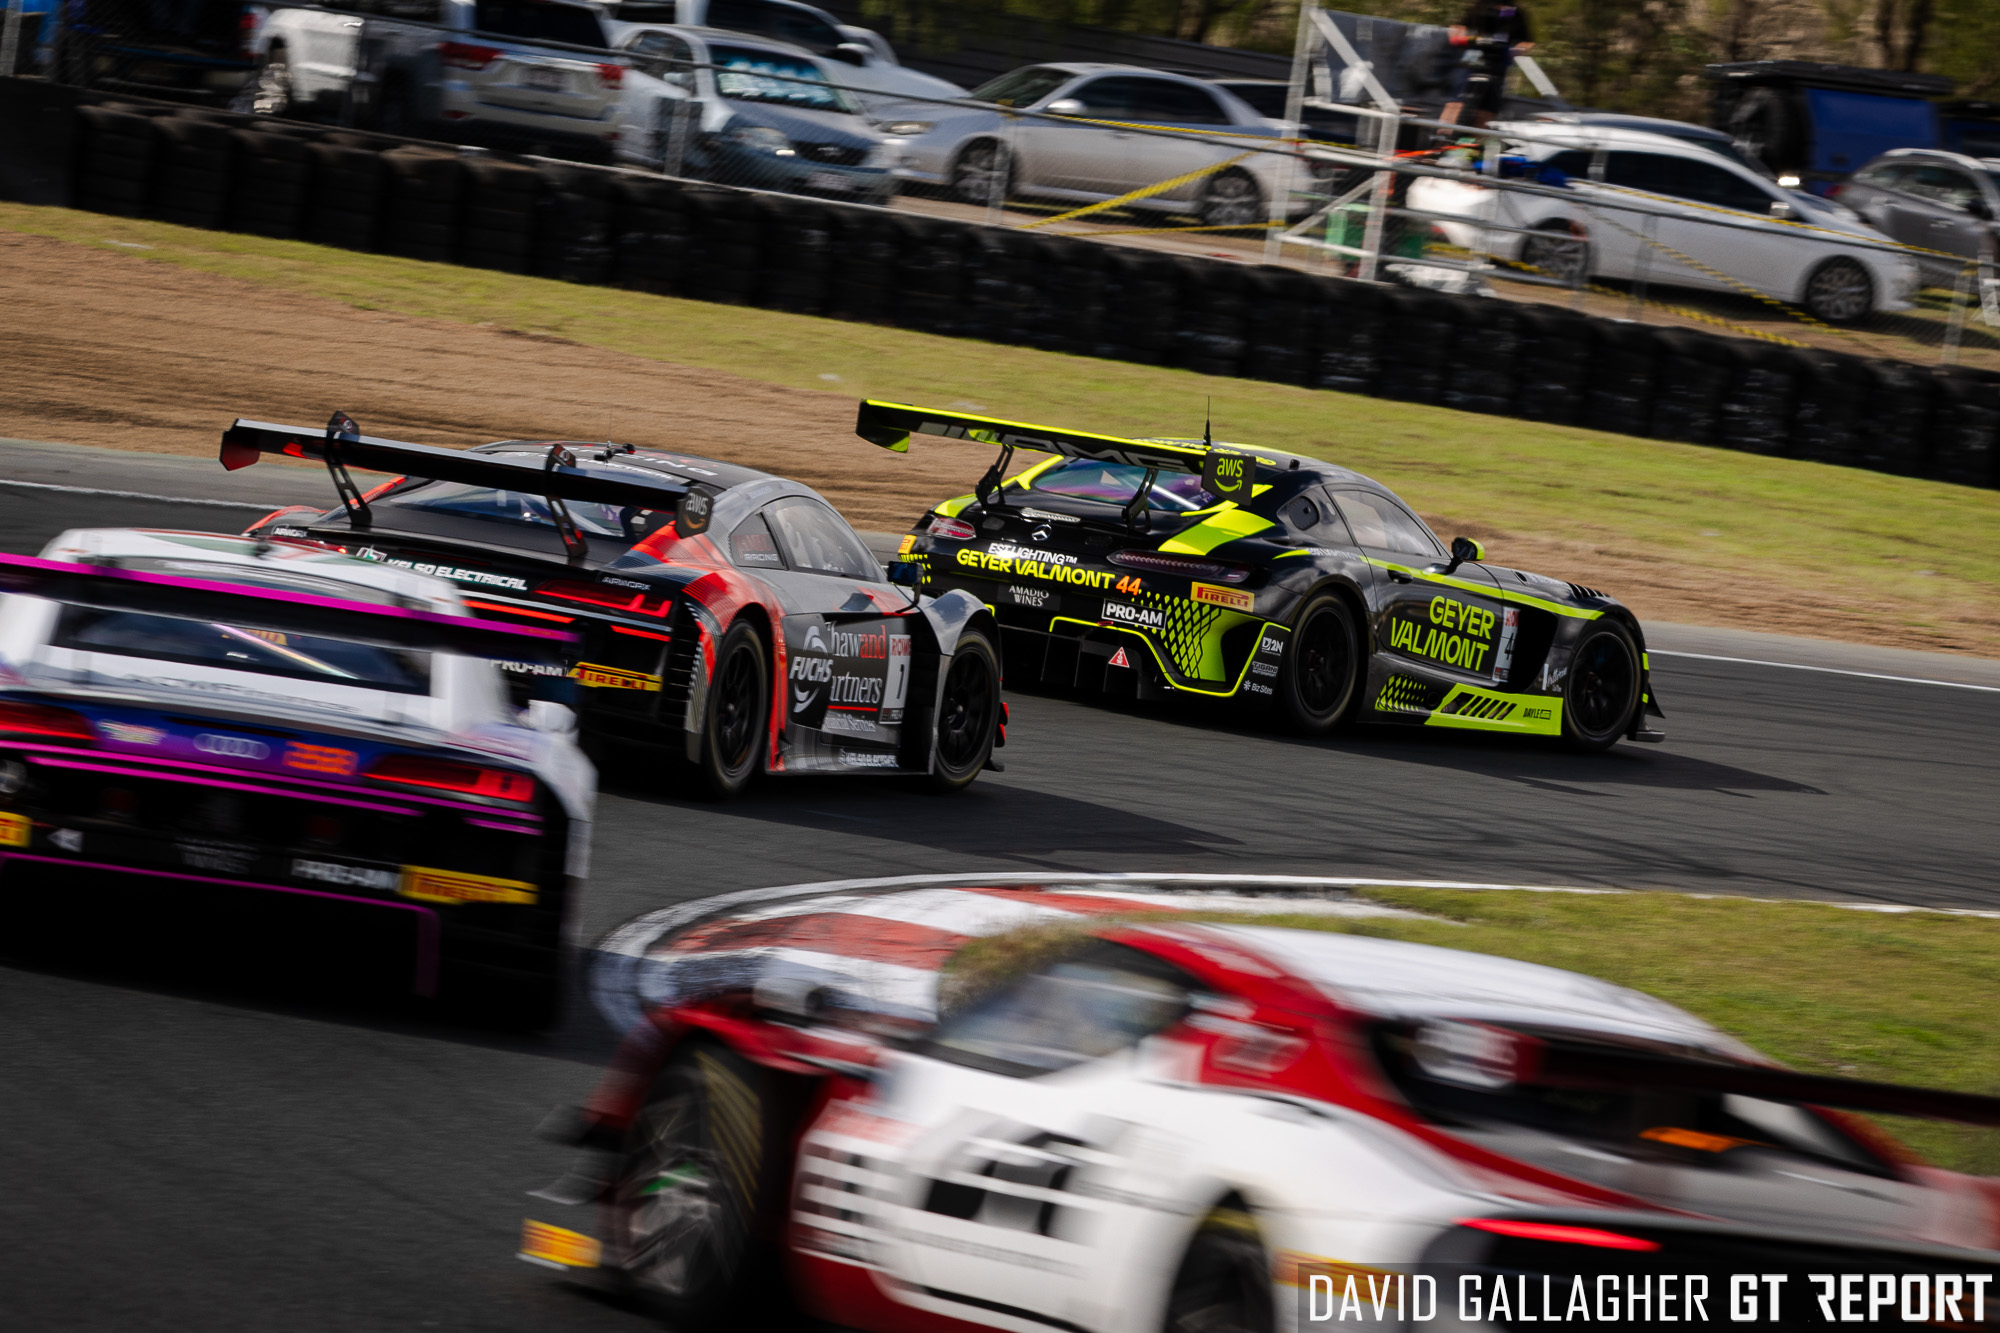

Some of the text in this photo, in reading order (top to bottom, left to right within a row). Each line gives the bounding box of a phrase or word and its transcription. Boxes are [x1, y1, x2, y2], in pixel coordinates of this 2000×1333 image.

[1216, 457, 1244, 478] aws
[435, 565, 528, 591] ELECTRICAL
[956, 548, 1142, 596] GEYER VALMONT 44
[1009, 585, 1049, 599] AMADIO
[1014, 594, 1043, 607] WINES
[1196, 586, 1249, 608] PIRELLI
[1105, 602, 1163, 626] PRO-AM
[1429, 595, 1495, 640] GEYER
[1390, 617, 1490, 671] VALMONT
[578, 664, 646, 690] PIRELLI
[789, 656, 833, 683] FUCHS
[898, 663, 905, 700] 1
